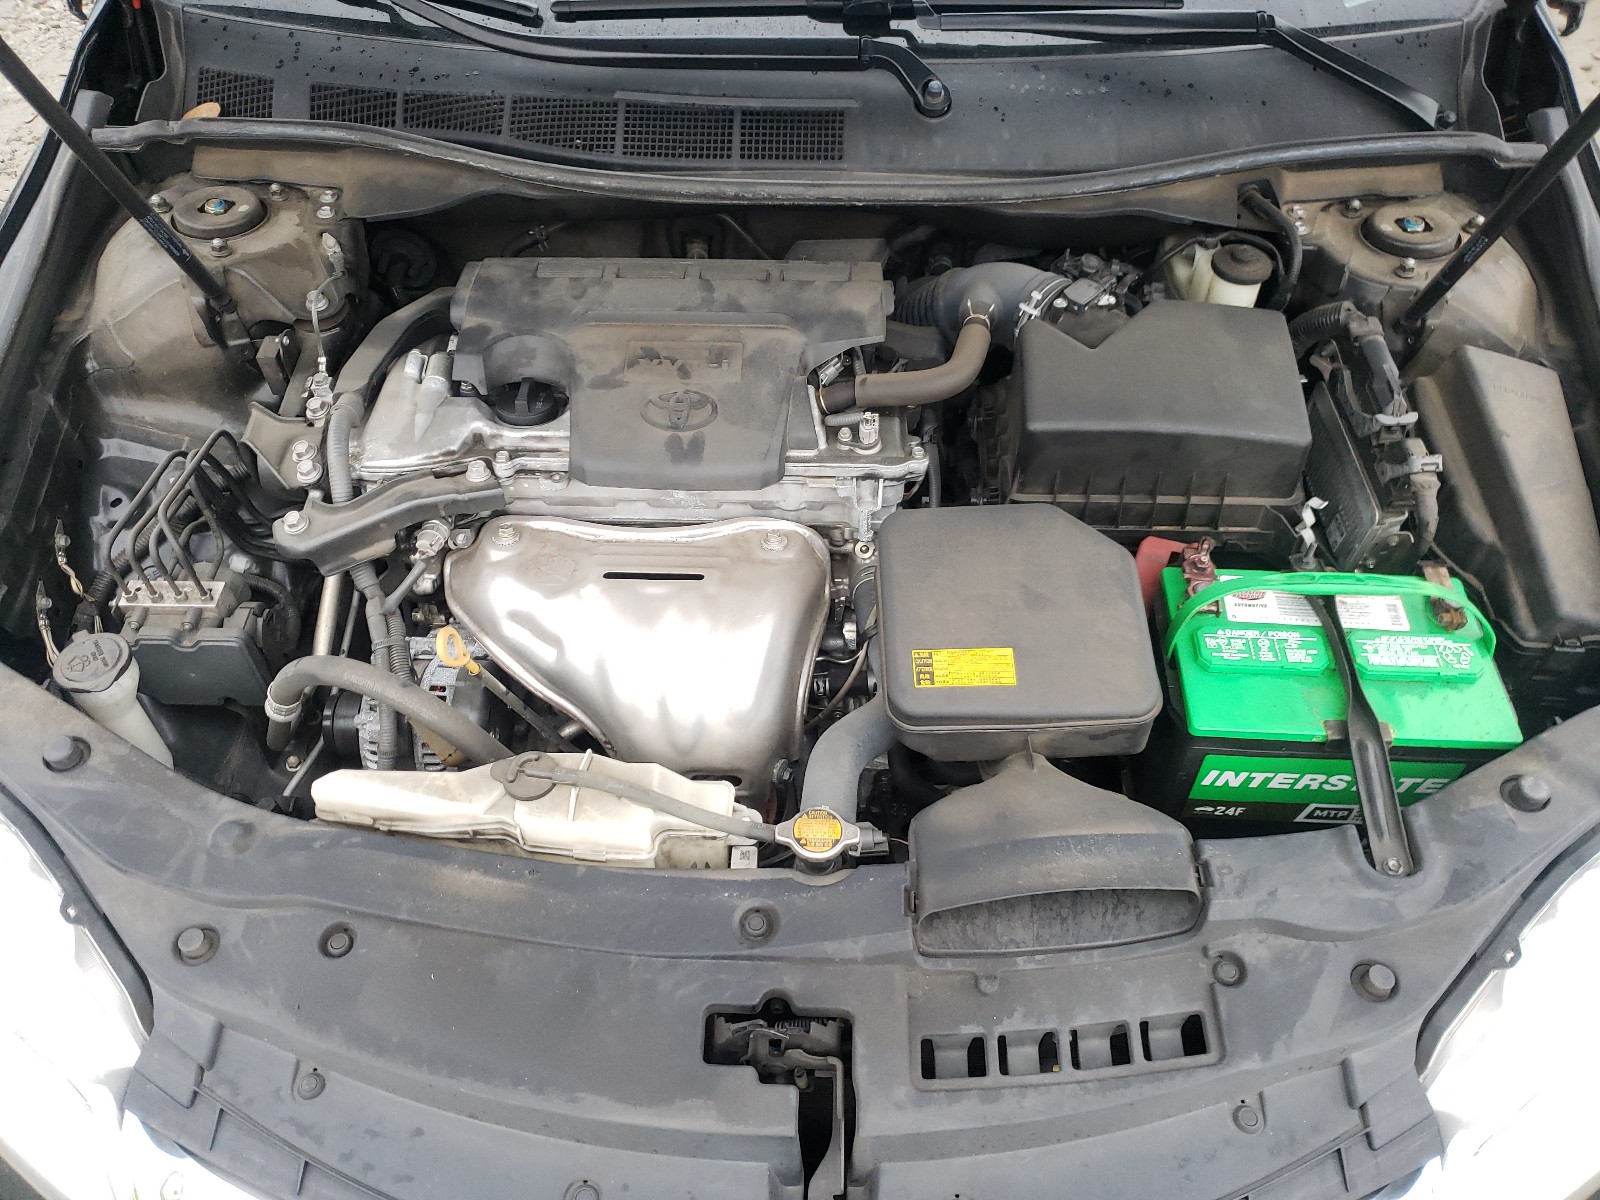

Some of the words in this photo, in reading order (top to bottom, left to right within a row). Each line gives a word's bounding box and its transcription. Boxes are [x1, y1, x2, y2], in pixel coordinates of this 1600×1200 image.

[1200, 769, 1451, 795] INTERSTE
[1213, 805, 1247, 817] 24F
[1312, 809, 1349, 818] MTP
